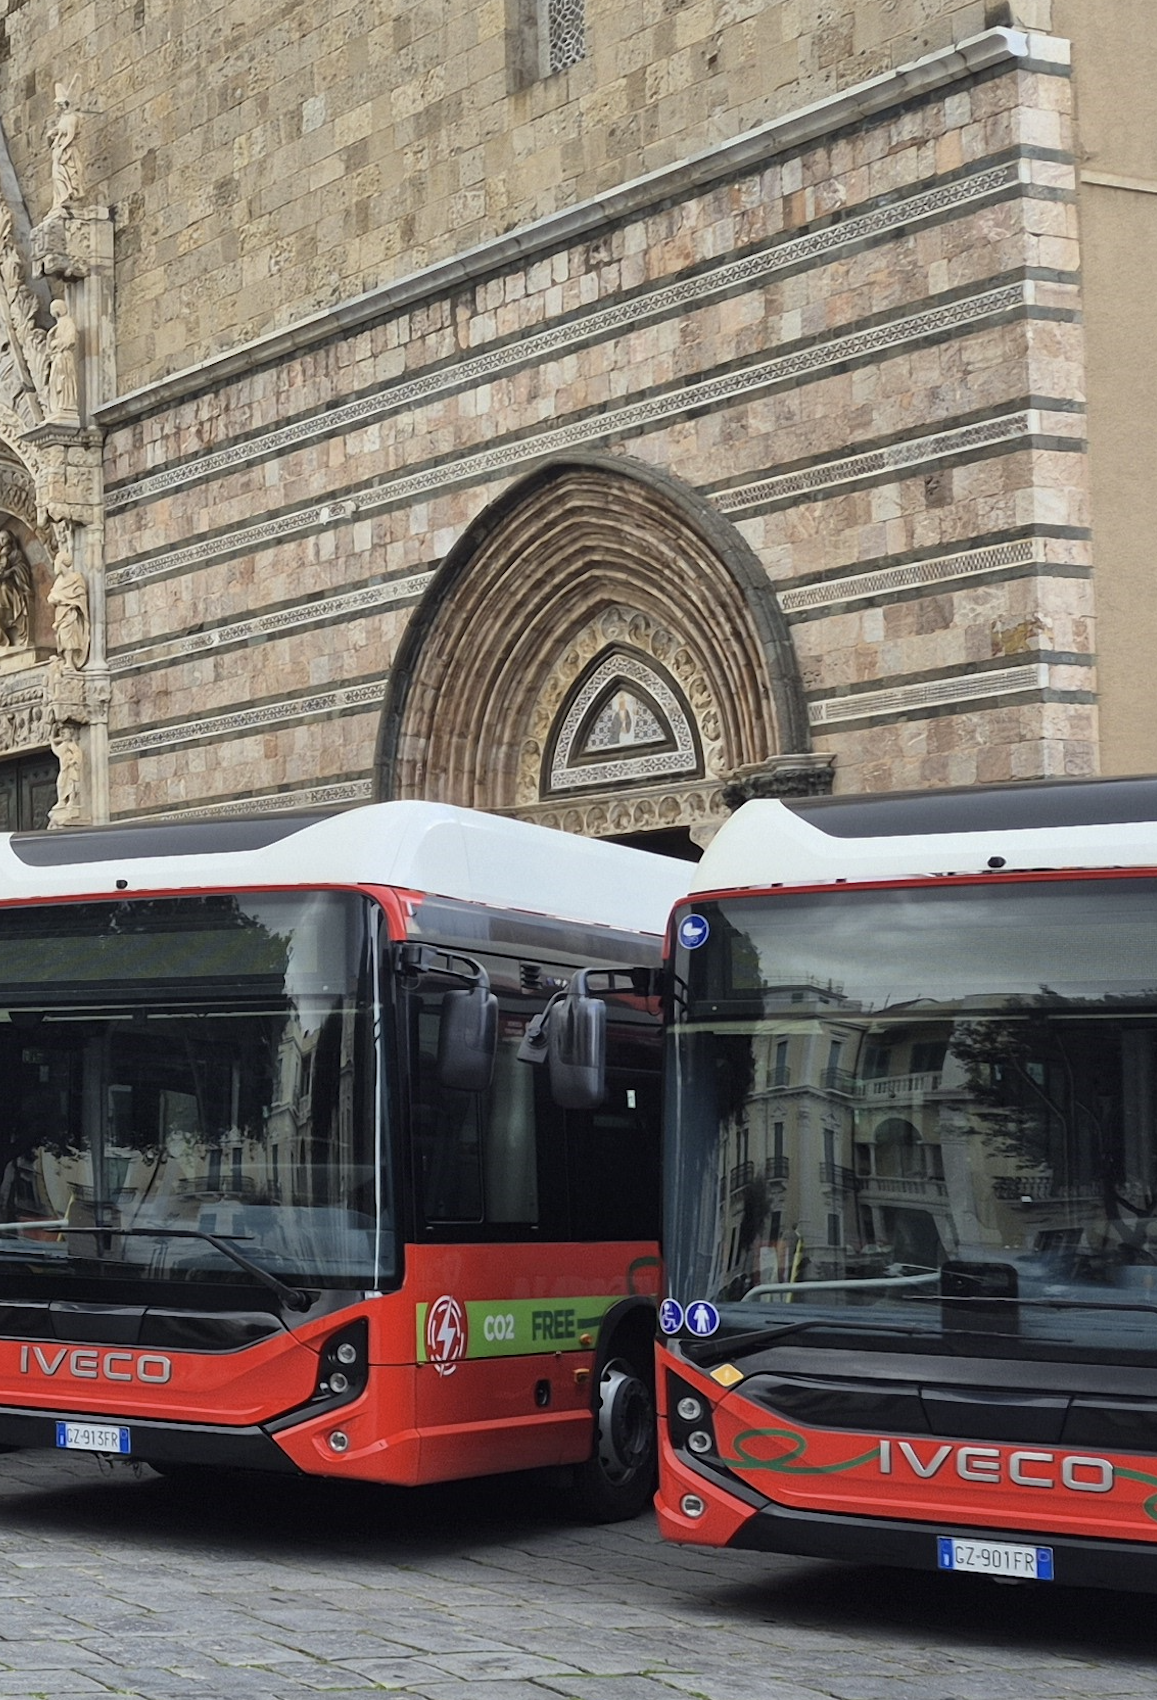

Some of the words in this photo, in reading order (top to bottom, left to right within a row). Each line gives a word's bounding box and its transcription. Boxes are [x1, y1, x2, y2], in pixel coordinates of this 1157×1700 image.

[483, 1313, 515, 1341] CO2
[531, 1308, 576, 1341] FREE
[20, 1345, 172, 1384] IVECO
[879, 1439, 1114, 1493] IVECO
